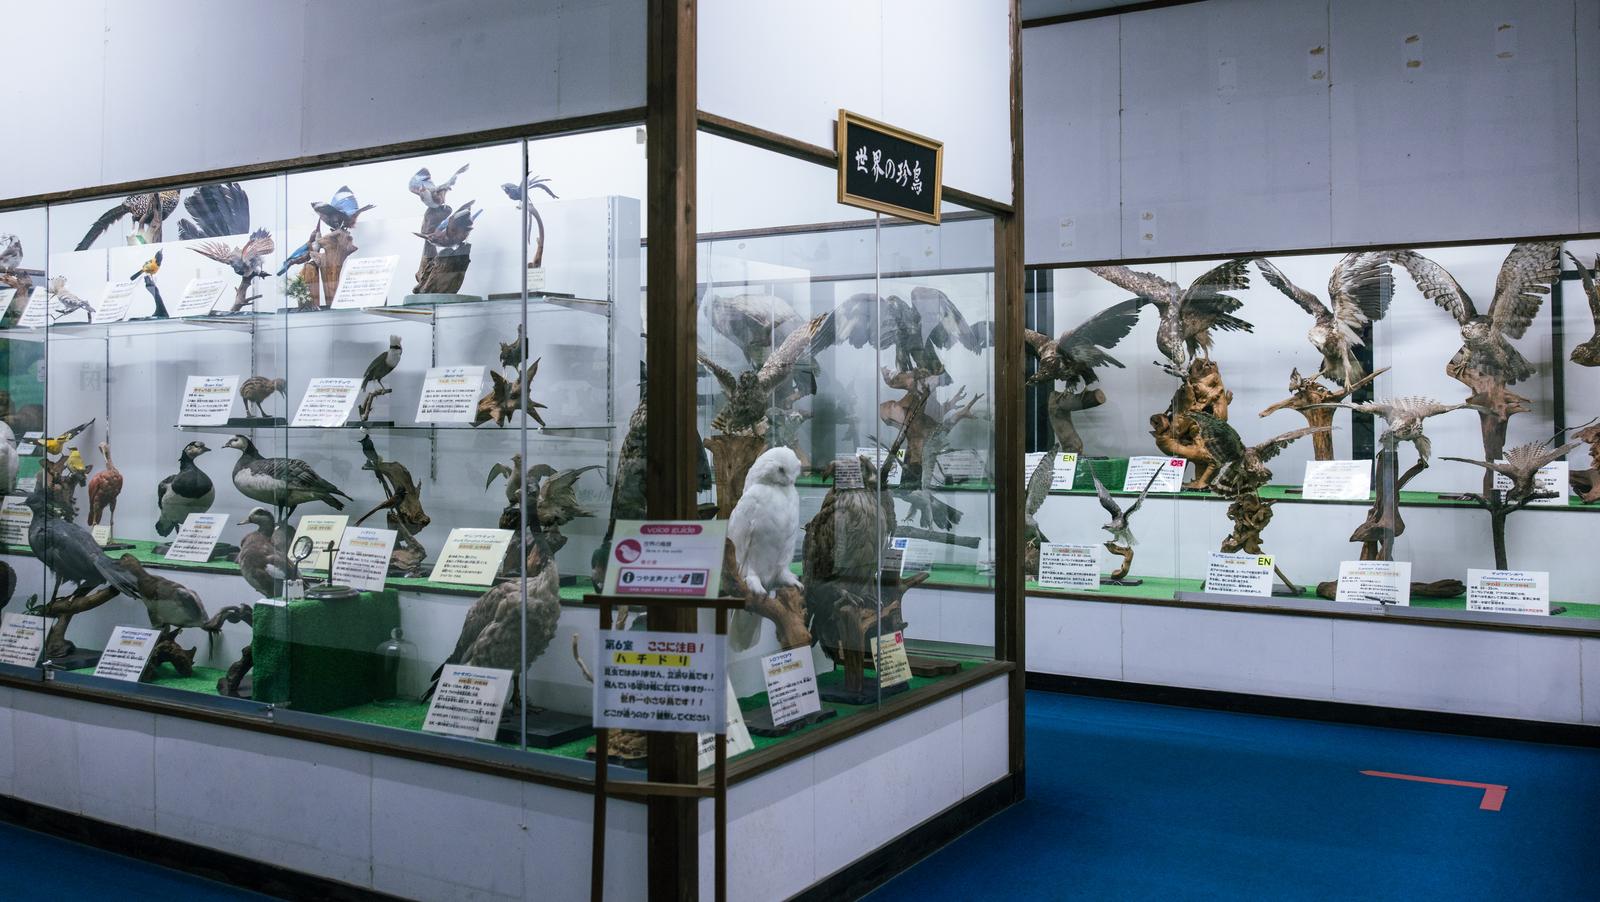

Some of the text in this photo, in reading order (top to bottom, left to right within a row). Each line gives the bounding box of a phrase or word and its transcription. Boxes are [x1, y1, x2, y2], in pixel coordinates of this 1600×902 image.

[855, 146, 923, 195] 世界の珍鳥
[647, 526, 695, 535] voice guide
[1258, 557, 1272, 566] EN
[605, 639, 704, 654] 第6室 ここに注目！
